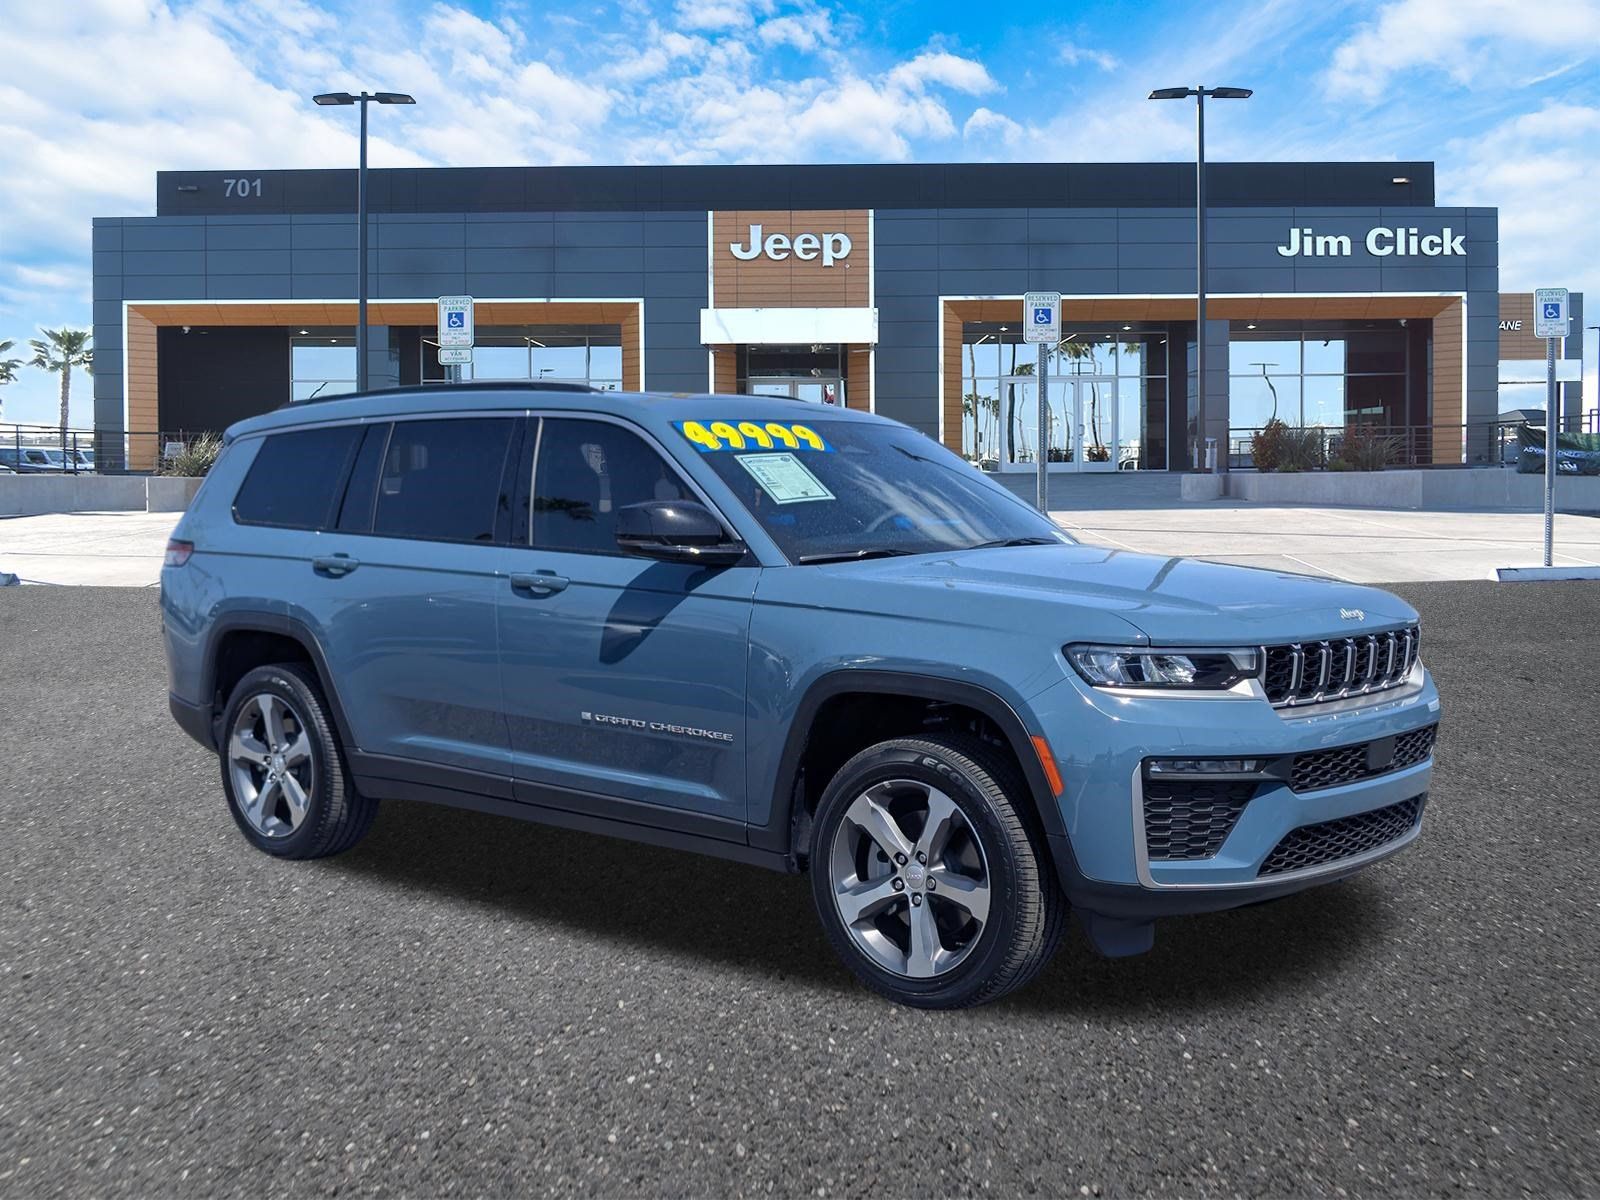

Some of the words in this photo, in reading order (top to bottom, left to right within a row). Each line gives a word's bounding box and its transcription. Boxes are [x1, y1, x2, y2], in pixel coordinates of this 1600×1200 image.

[223, 178, 263, 198] 701
[730, 224, 852, 267] Jeep
[1277, 227, 1352, 257] Jim
[1366, 227, 1467, 257] Click
[1498, 320, 1522, 331] ANE
[683, 421, 825, 451] 49999
[1339, 607, 1365, 622] Jeep
[594, 713, 646, 729] GRAND
[650, 721, 734, 742] CHEROKEE
